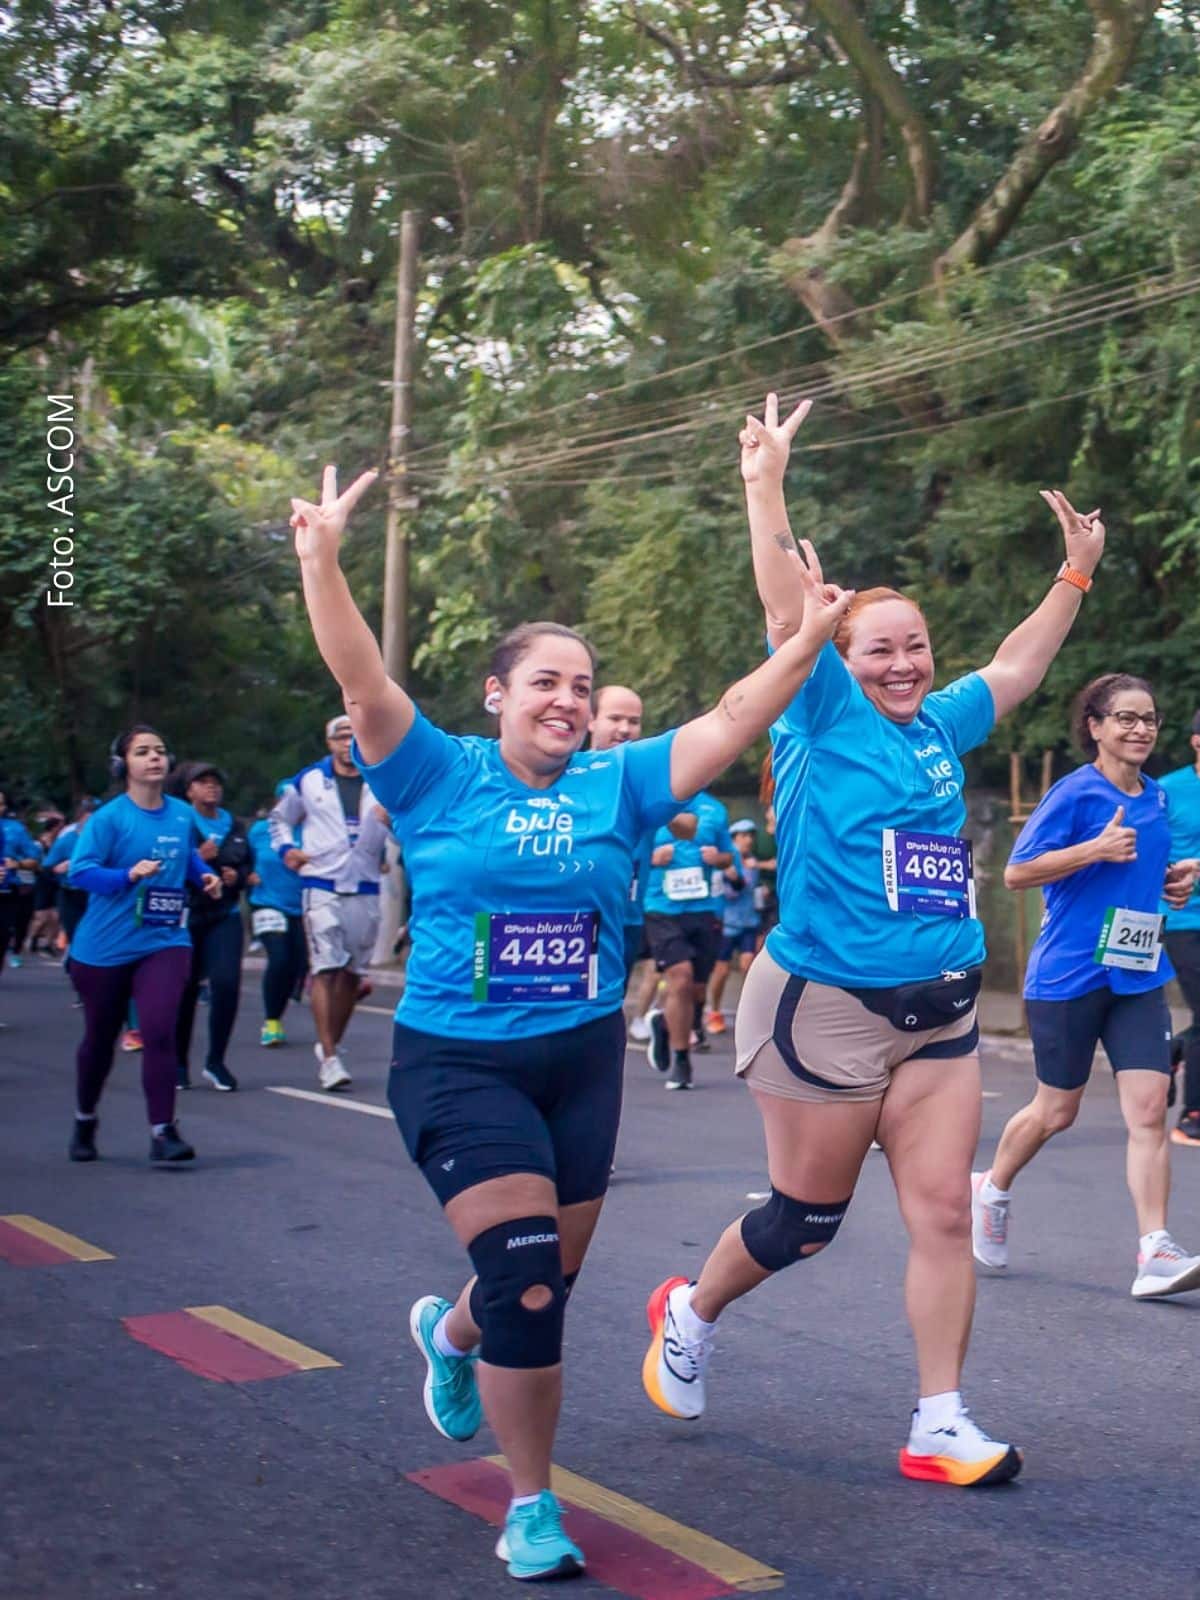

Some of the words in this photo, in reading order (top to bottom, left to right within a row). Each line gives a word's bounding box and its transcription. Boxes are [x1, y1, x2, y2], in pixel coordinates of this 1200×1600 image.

[504, 808, 574, 833] blue
[516, 834, 574, 857] run
[884, 849, 894, 894] BRANCO
[904, 854, 965, 884] 4623
[536, 921, 562, 934] blue
[563, 922, 583, 933] run
[1117, 927, 1155, 949] 2411
[474, 940, 486, 980] VERDE
[499, 937, 586, 966] 4432
